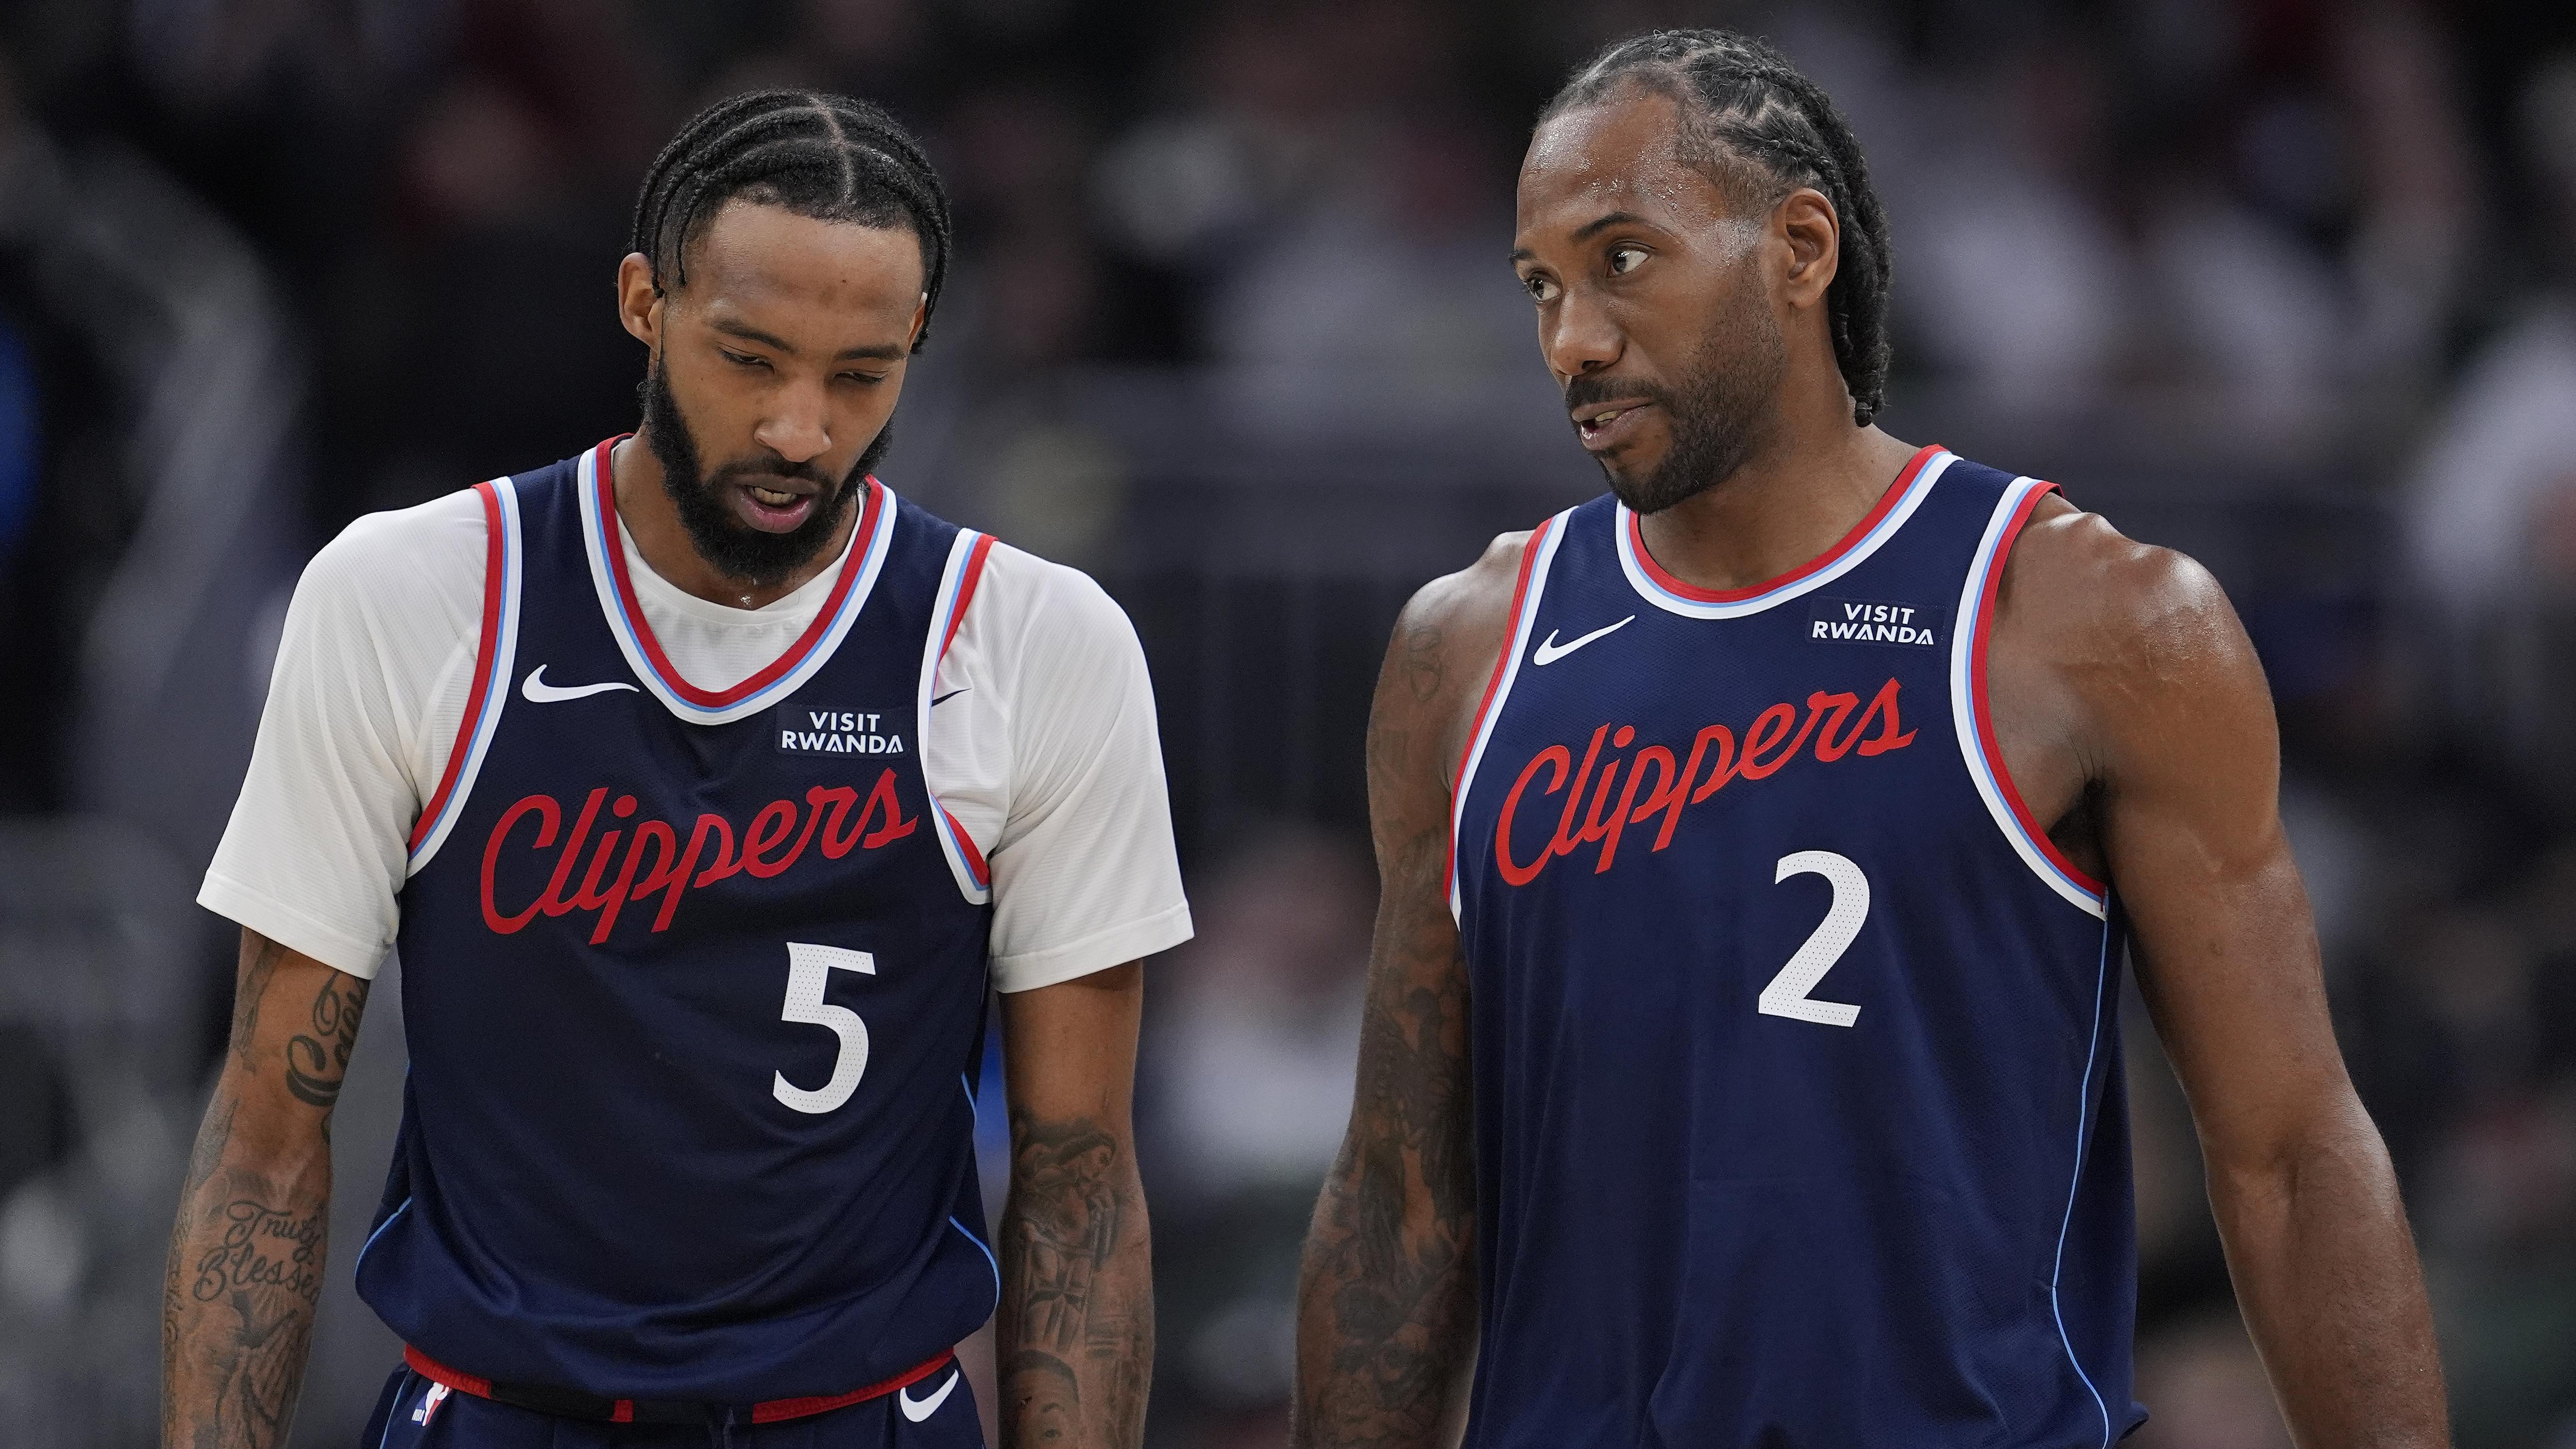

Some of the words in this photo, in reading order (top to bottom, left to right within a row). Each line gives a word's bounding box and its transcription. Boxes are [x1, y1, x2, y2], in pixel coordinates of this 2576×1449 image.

[1812, 621, 1934, 645] RWANDA
[1844, 603, 1915, 625] VISIT
[782, 730, 904, 754] RWANDA
[809, 712, 880, 733] VISIT
[1495, 677, 1918, 886] Clippers
[481, 767, 919, 945] Clippers
[1758, 850, 1870, 1027] 2
[772, 941, 876, 1114] 5
